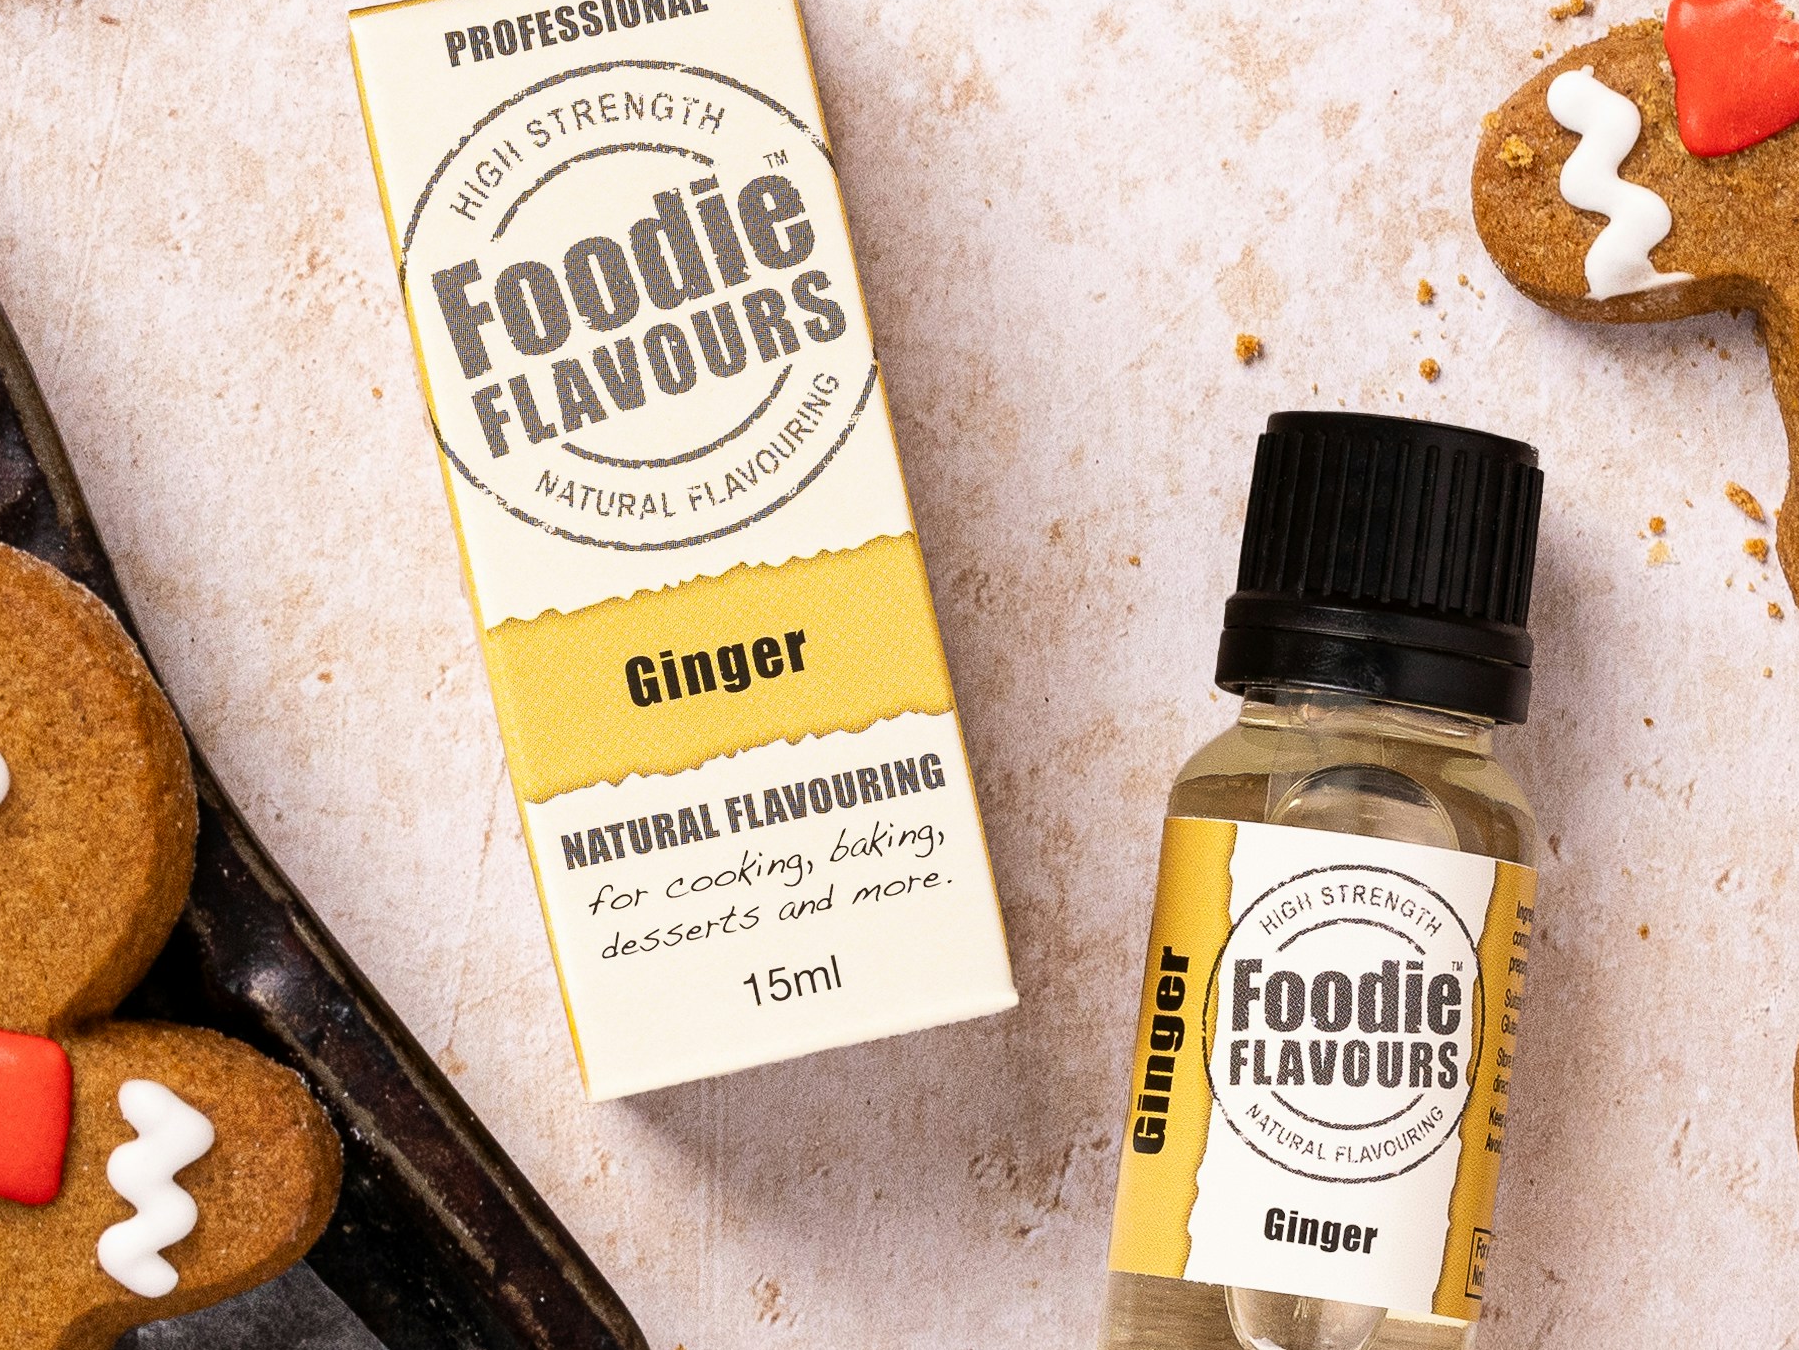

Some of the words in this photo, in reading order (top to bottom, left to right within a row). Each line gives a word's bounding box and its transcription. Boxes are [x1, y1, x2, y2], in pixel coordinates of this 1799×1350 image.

[450, 140, 523, 221] HIGH
[526, 92, 725, 148] STRENGTH
[431, 173, 815, 379] Foodie
[471, 269, 846, 459] FLAVOURS
[535, 468, 676, 520] NATURAL
[689, 371, 839, 510] FLAVOURING
[624, 629, 806, 707] Ginger
[561, 804, 720, 870] NATURAL
[725, 753, 946, 832] FLAVOURING
[588, 885, 649, 916] for
[666, 850, 813, 899] cooking,
[830, 821, 946, 863] baking,
[1259, 892, 1312, 935] HIGH
[1321, 885, 1442, 937] STRENGTH
[601, 903, 760, 959] desserts
[779, 885, 833, 920] and
[853, 873, 953, 906] more.
[743, 955, 842, 1007] 15ml
[1231, 958, 1462, 1035] Foodie
[1133, 946, 1191, 1155] Ginger
[1228, 1038, 1459, 1091] FLAVOURS
[1246, 1104, 1326, 1160] NATURAL
[1335, 1106, 1444, 1163] FLAVOURING
[1264, 1207, 1378, 1254] Ginger
